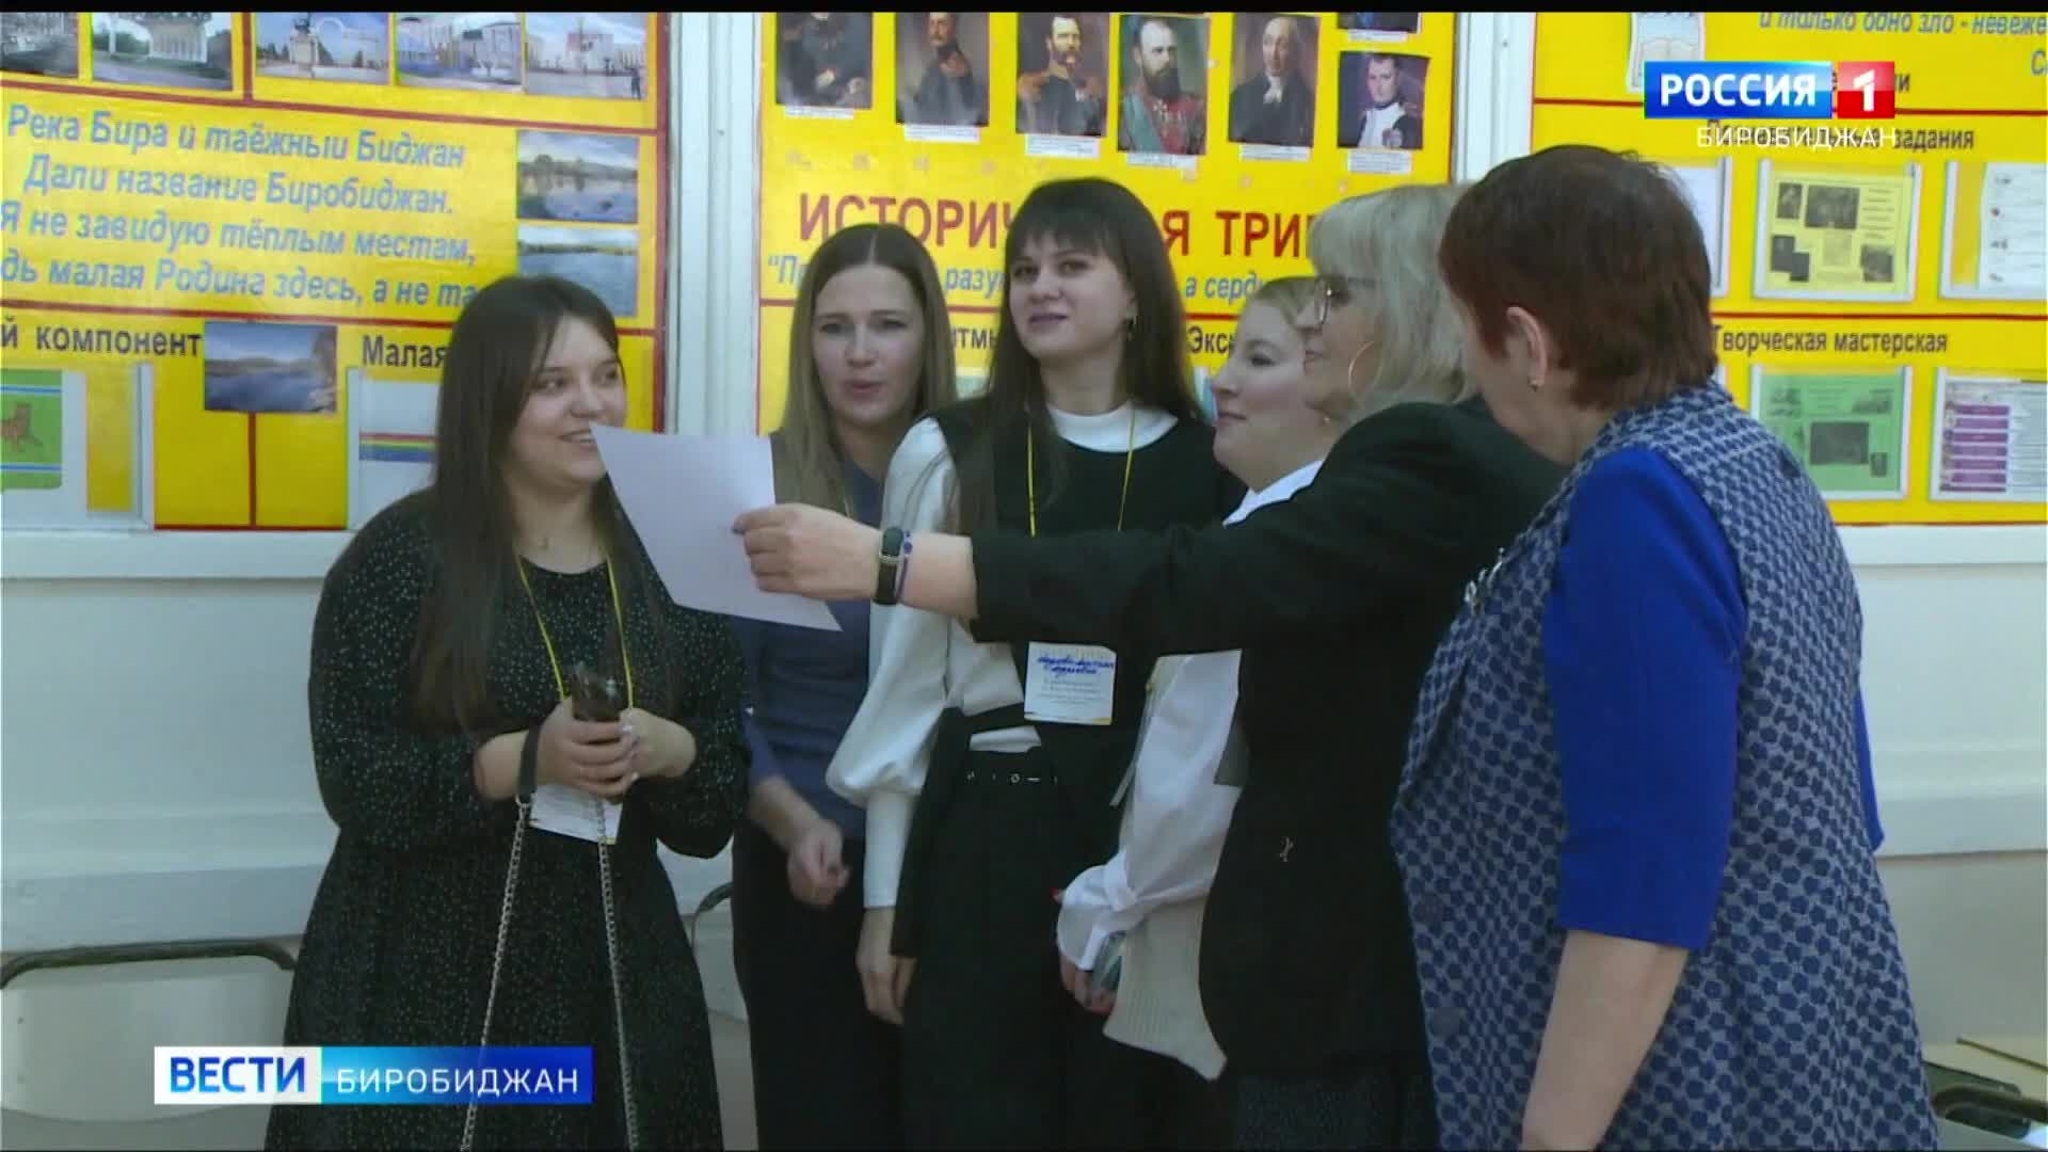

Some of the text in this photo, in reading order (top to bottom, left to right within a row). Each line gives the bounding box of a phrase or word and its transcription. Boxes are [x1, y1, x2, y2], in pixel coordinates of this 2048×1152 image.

[1918, 14, 1954, 34] зло
[8, 104, 80, 141] Река
[91, 110, 168, 154] Бира
[178, 128, 196, 149] и
[357, 129, 465, 167] Биджан
[23, 153, 453, 214] Дали название Биробиджан.
[0, 201, 476, 267] Я не завидую тёплым местам,
[48, 257, 145, 290] малая
[155, 257, 265, 296] Родина
[273, 266, 363, 307] здесь,
[373, 279, 388, 303] а
[396, 281, 428, 306] не
[1185, 277, 1197, 297] а
[1205, 271, 1262, 305] серд
[36, 326, 202, 356] компонент
[362, 334, 448, 368] Малая
[1834, 332, 1948, 357] мастерская
